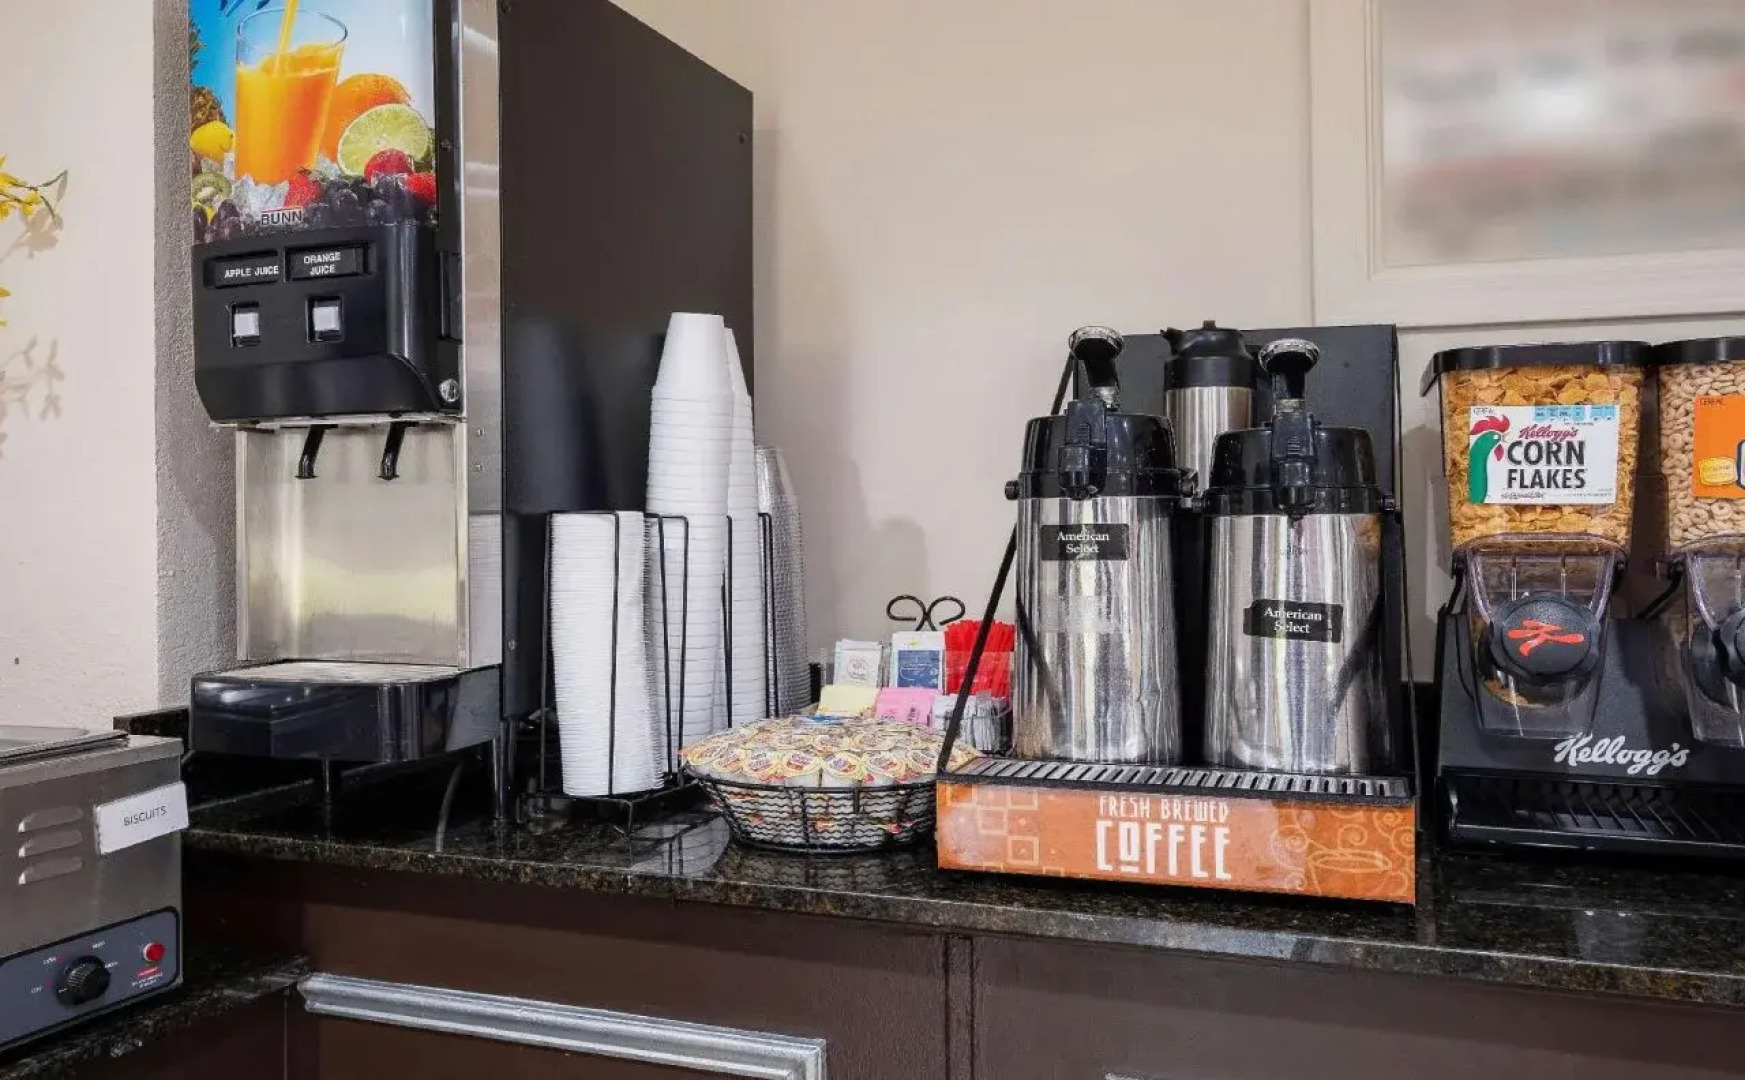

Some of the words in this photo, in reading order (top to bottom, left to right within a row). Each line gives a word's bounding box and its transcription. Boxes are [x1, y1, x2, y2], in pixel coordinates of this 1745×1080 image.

[261, 210, 303, 226] BUNN
[303, 251, 342, 264] ORANGE
[224, 268, 252, 279] APPLE
[254, 265, 280, 276] JUICE
[309, 264, 336, 276] JUICE
[1518, 424, 1579, 443] Kellogg's
[1506, 440, 1586, 466] CORN
[1506, 468, 1587, 489] FLAKES
[1057, 531, 1109, 541] American
[1065, 543, 1100, 553] Select
[1264, 606, 1322, 621] American
[1274, 620, 1311, 634] Select
[1553, 732, 1690, 775] Kellogg's
[123, 805, 167, 827] BISCUITS
[1100, 795, 1150, 819] FRESH
[1161, 798, 1229, 823] BREWED
[1096, 819, 1232, 880] COFFEE
